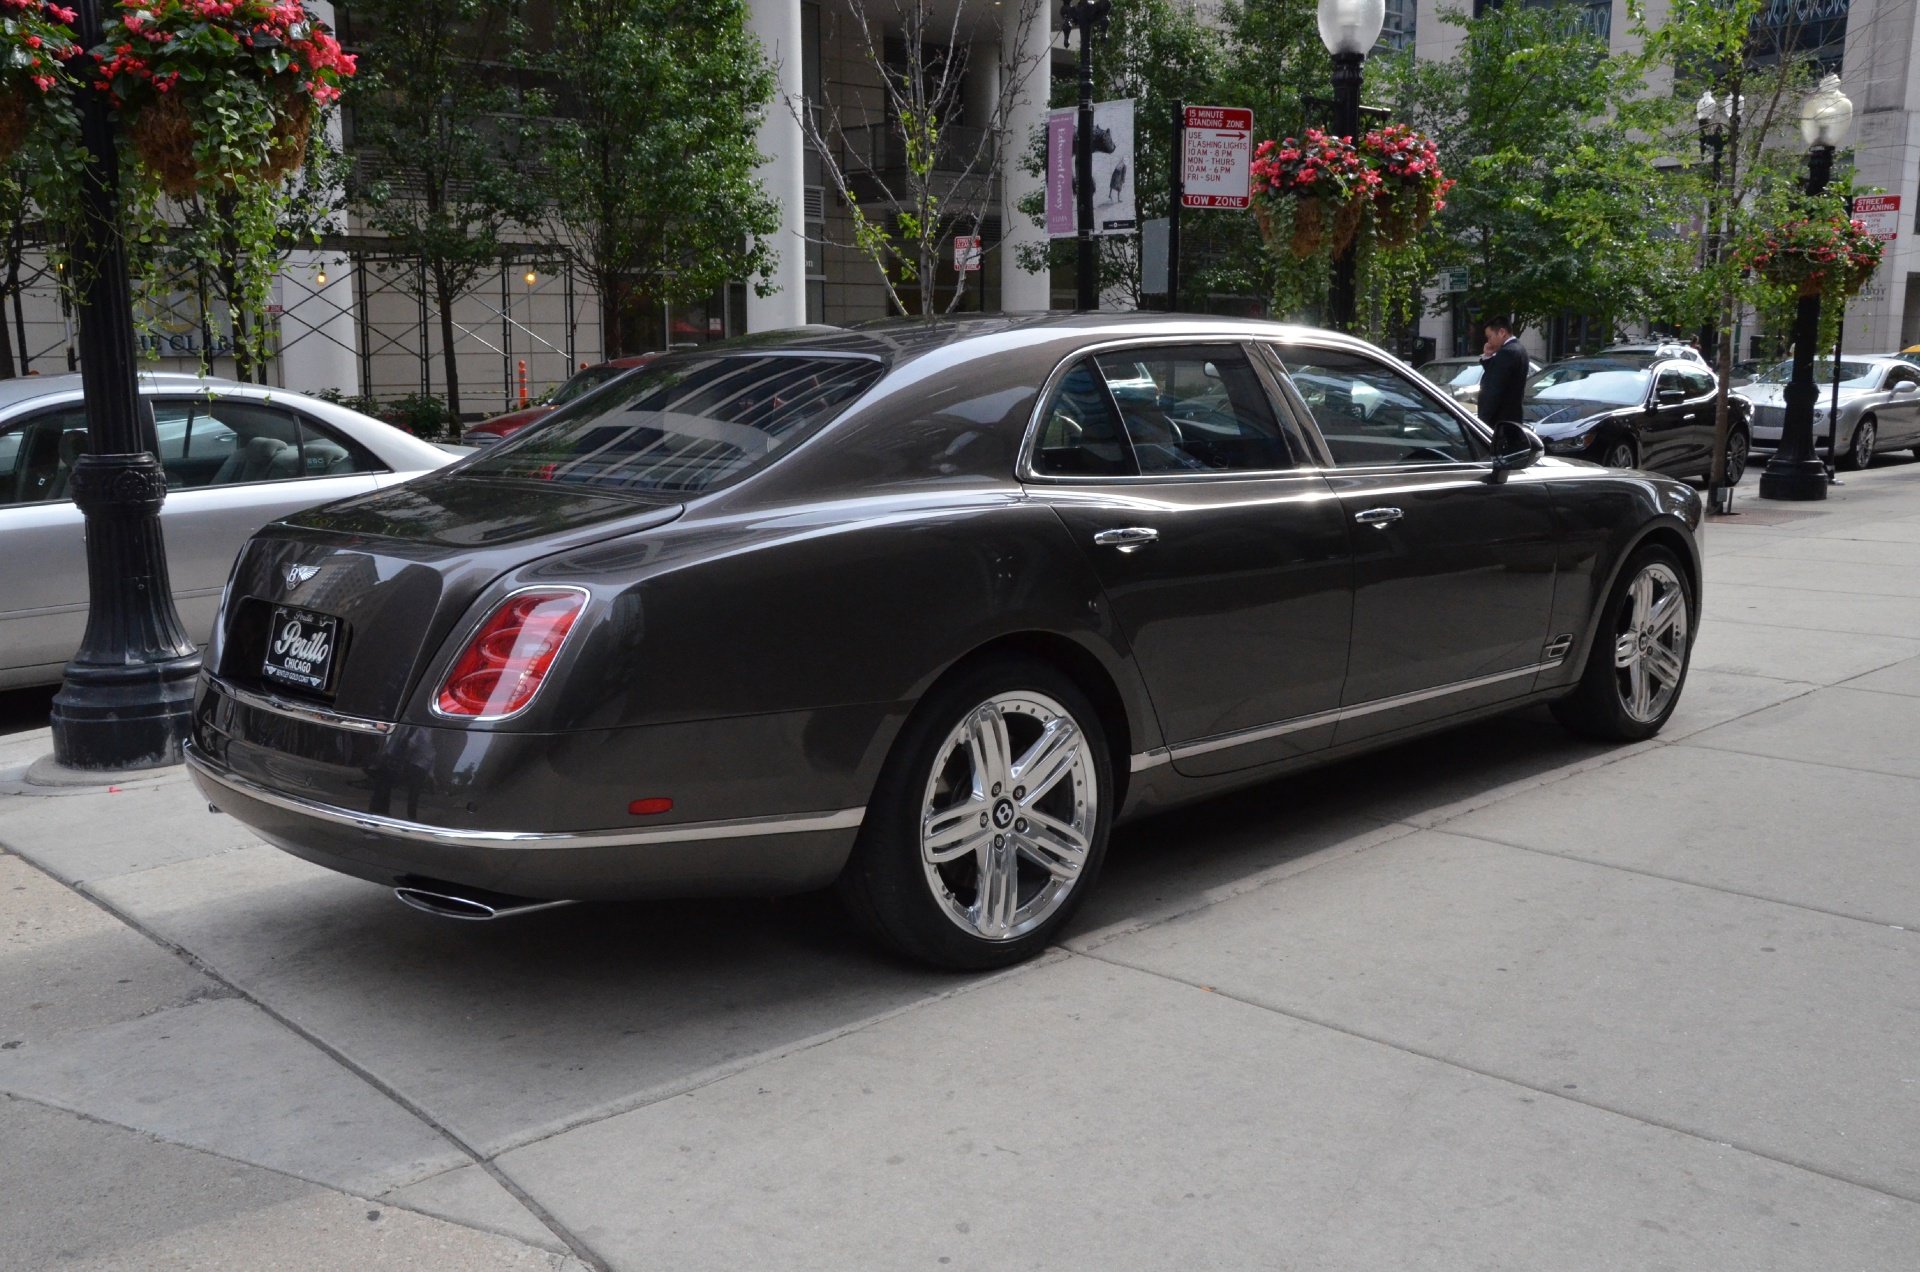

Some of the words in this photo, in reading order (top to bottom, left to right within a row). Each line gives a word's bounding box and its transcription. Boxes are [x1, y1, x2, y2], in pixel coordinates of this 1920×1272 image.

[1189, 109, 1196, 117] 15
[1189, 118, 1222, 127] STANDING
[1226, 120, 1244, 128] ZONE
[1188, 131, 1202, 139] USE
[1188, 140, 1222, 149] FLASHING
[1223, 142, 1248, 150] LIGHTS
[1211, 157, 1235, 166] THURS
[1205, 174, 1221, 182] SUN
[1187, 195, 1210, 205] TOW
[1214, 196, 1243, 207] ZONE
[1856, 203, 1895, 212] CLEANING
[274, 620, 329, 664] Perillo
[284, 657, 312, 674] CHICAGO
